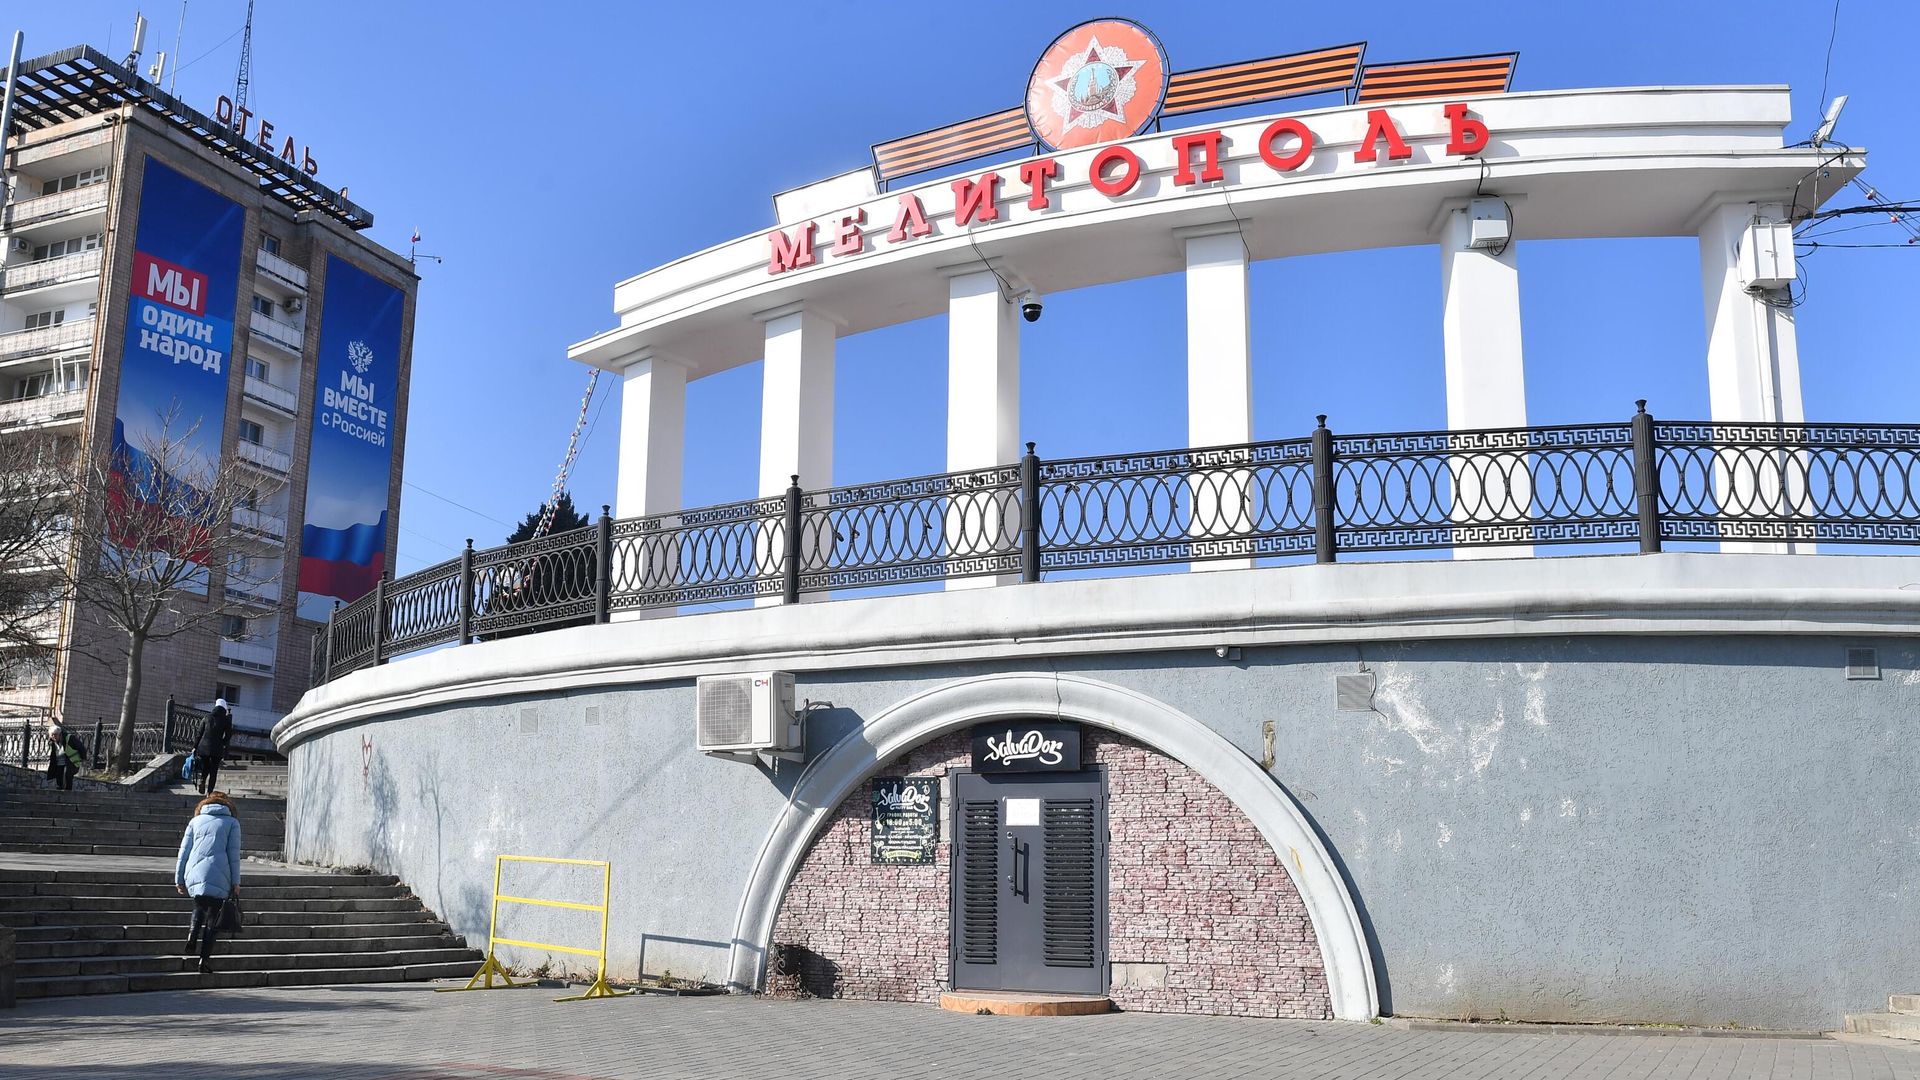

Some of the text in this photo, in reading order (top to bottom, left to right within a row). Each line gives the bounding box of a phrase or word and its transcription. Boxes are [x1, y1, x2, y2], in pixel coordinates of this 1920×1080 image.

[216, 95, 318, 176] ОТЕЛЬ
[767, 103, 1490, 276] МЕЛИТОПОЛЬ
[142, 305, 213, 344] один
[139, 328, 222, 375] народ
[340, 370, 375, 404] МЫ
[323, 386, 387, 430] ВМЕСТЕ
[321, 412, 385, 448] с Россией
[754, 679, 769, 687] CH
[983, 729, 1063, 766] SalvaDor
[877, 783, 931, 812] SalvaDor
